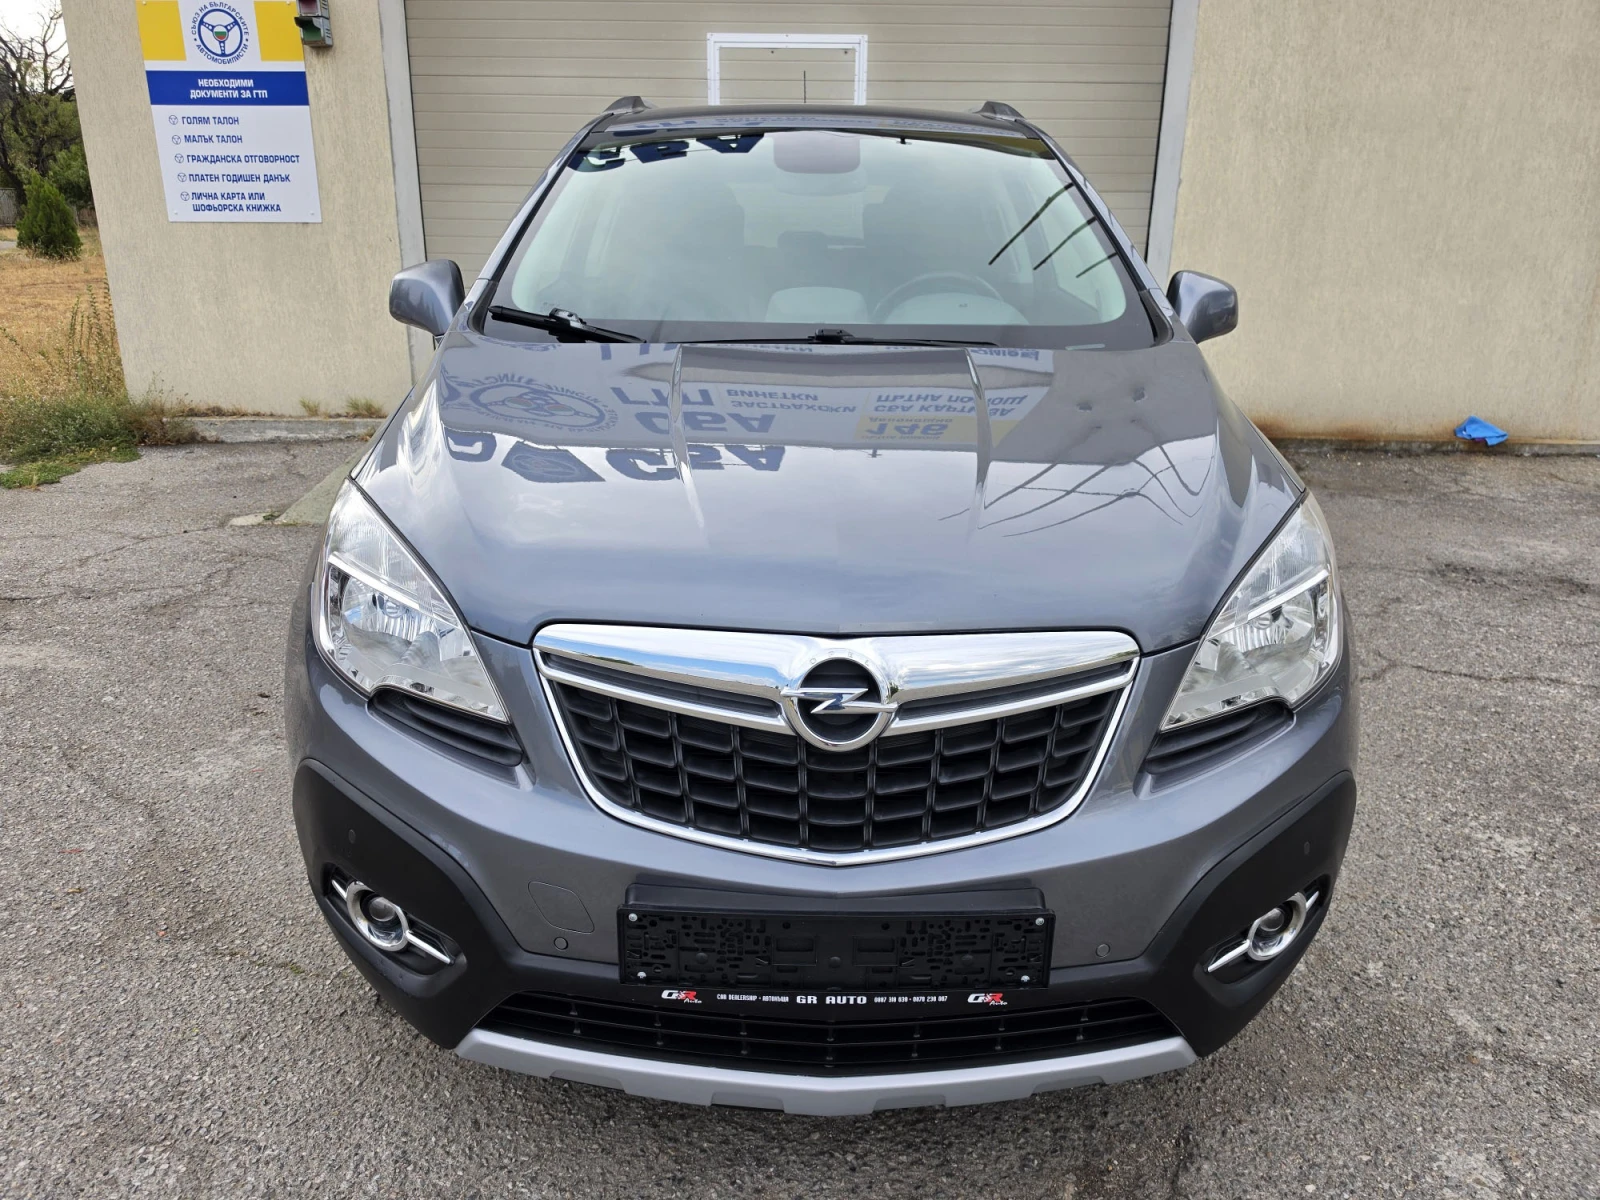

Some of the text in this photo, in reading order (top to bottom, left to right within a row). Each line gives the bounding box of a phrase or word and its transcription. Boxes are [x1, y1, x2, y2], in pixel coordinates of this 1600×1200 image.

[191, 1, 250, 36] СЪЮЗ НА БЪЛГАРСКИТЕ
[196, 43, 249, 65] АВТОМОБИЛИСТИ
[198, 79, 254, 88] НЕОБХОДИМИ
[190, 90, 268, 100] ДОКУМЕНТИ ЗА ГТП
[182, 116, 240, 125] ГОЛЯМ ТАЛОН
[184, 134, 243, 144] МАЛЪК ТАЛОН
[187, 154, 300, 165] ГРАЖДАНСКА ОТГОВОРНОСТ
[189, 173, 291, 184] ПЛАТЕН ГОДИШЕН ДАНЪК
[191, 191, 265, 201] ЛИЧНА КАРТА ИЛИ
[193, 203, 281, 212] ШОФЬОРСКА КНИЖКА
[796, 995, 818, 1004] GR
[825, 995, 867, 1004] AUTO
